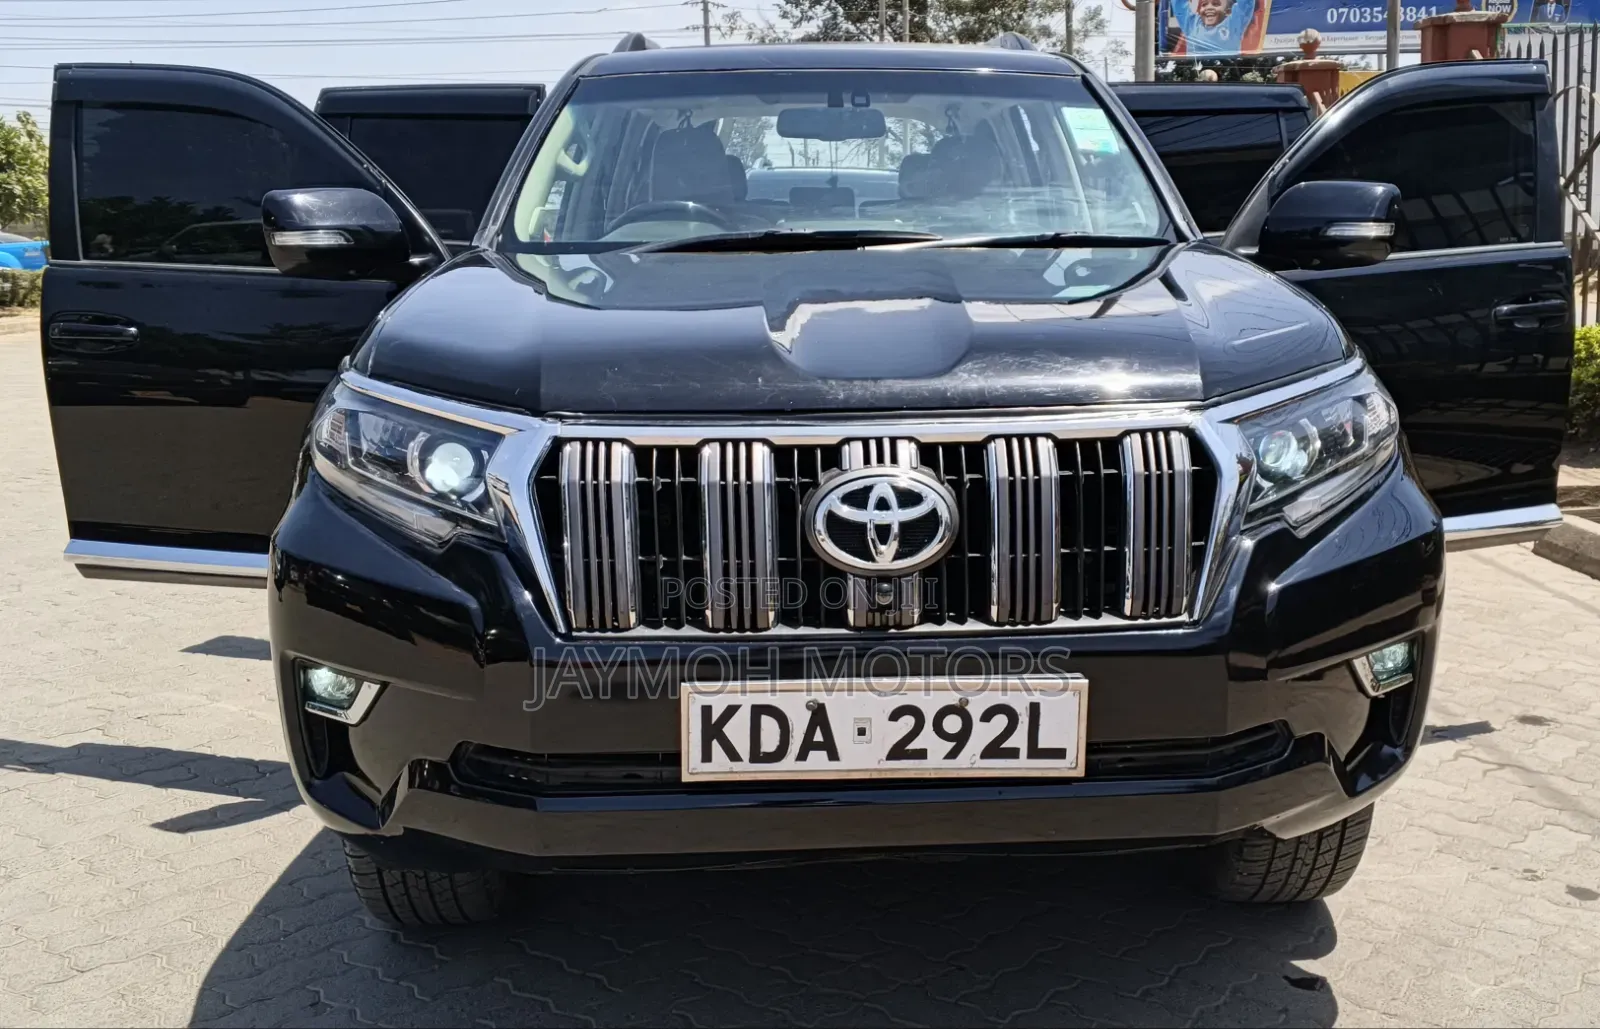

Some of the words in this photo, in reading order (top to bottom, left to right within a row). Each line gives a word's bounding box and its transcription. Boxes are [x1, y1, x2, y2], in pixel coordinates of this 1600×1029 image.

[1488, 4, 1512, 13] NOW
[701, 703, 840, 763] KDA
[886, 702, 1067, 761] 292L
